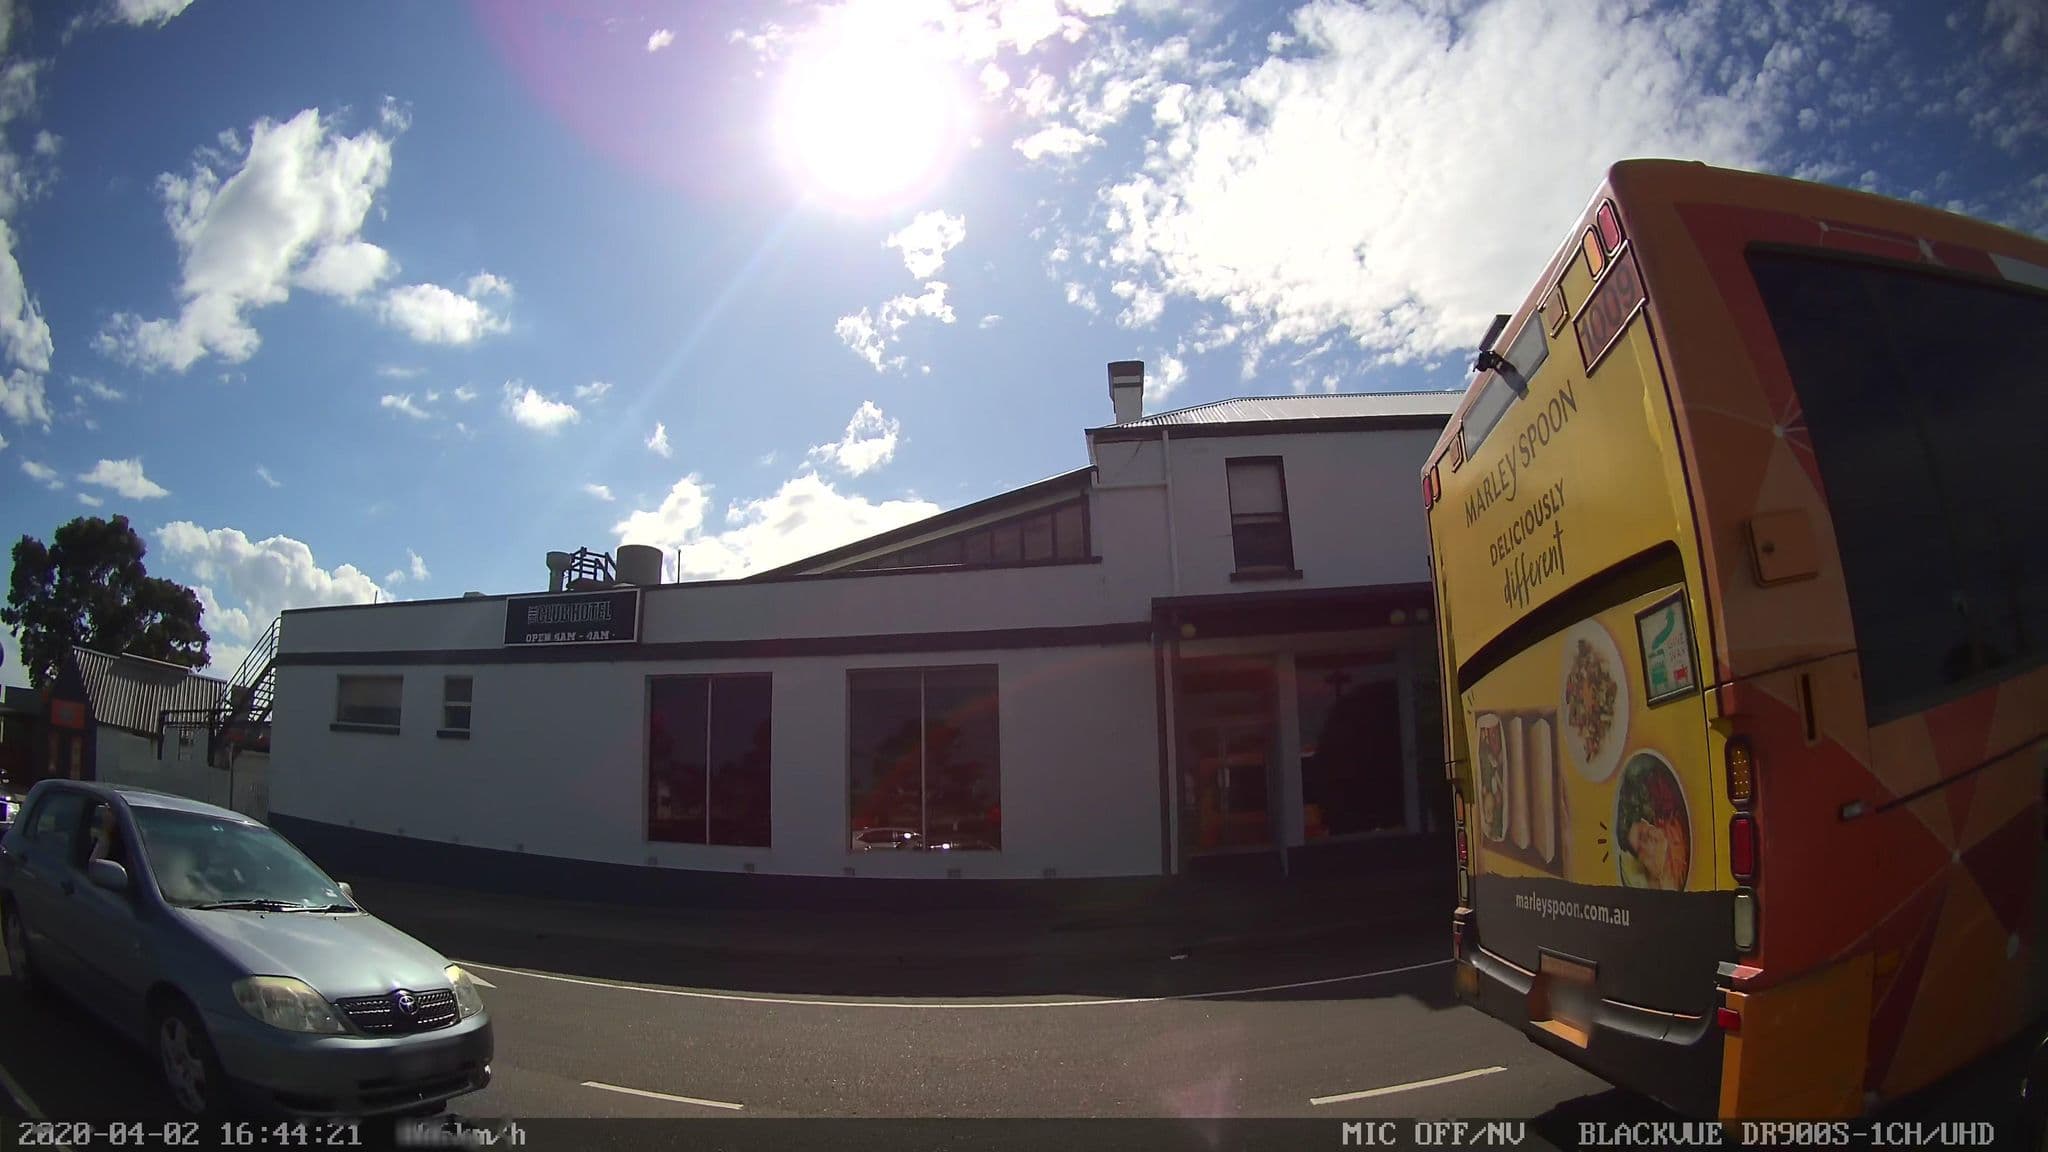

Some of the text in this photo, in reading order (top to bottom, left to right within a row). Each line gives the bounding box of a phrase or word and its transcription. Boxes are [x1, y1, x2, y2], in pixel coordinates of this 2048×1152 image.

[1580, 263, 1638, 357] 1009
[1464, 380, 1578, 528] MARLEY SPOON
[1489, 478, 1566, 566] DELICIOUSLY
[1503, 521, 1566, 609] different
[525, 633, 551, 642] OPEN
[570, 601, 611, 622] HOTEL
[1515, 891, 1630, 926] marleyspoon.com.au
